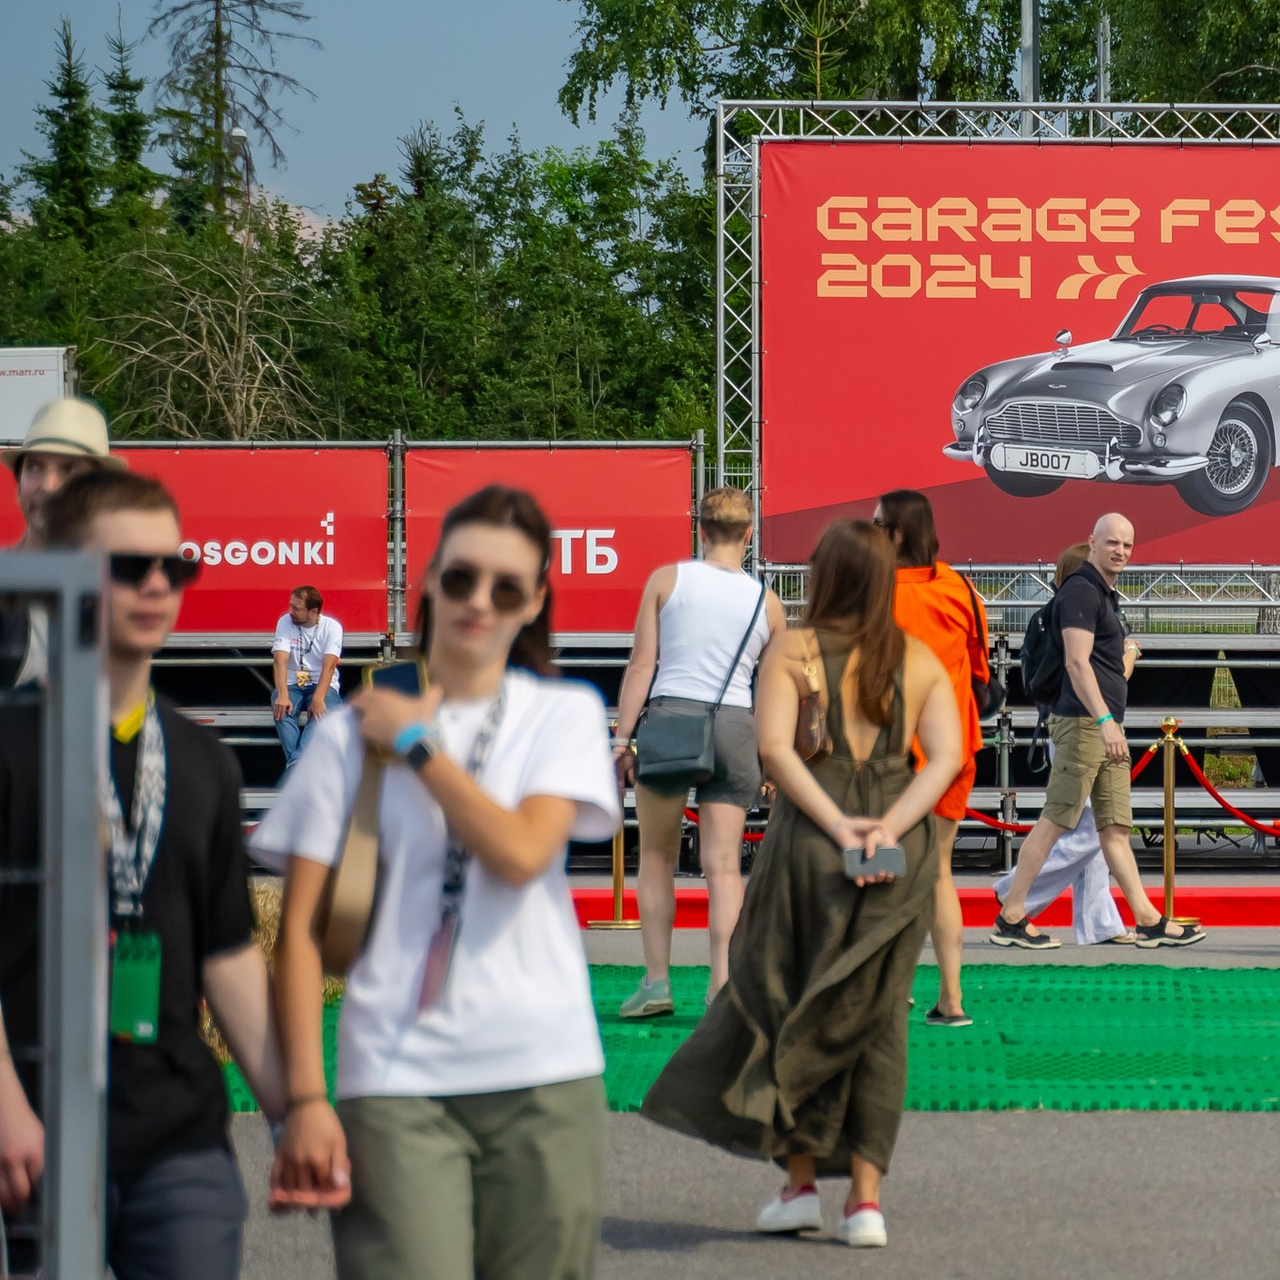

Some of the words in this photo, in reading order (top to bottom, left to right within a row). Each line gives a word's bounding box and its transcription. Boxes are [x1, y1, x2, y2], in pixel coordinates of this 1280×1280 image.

[816, 253, 1032, 299] 2024
[1019, 452, 1071, 471] JB007
[177, 541, 335, 566] OSGONKI
[548, 529, 618, 575] ТБ
